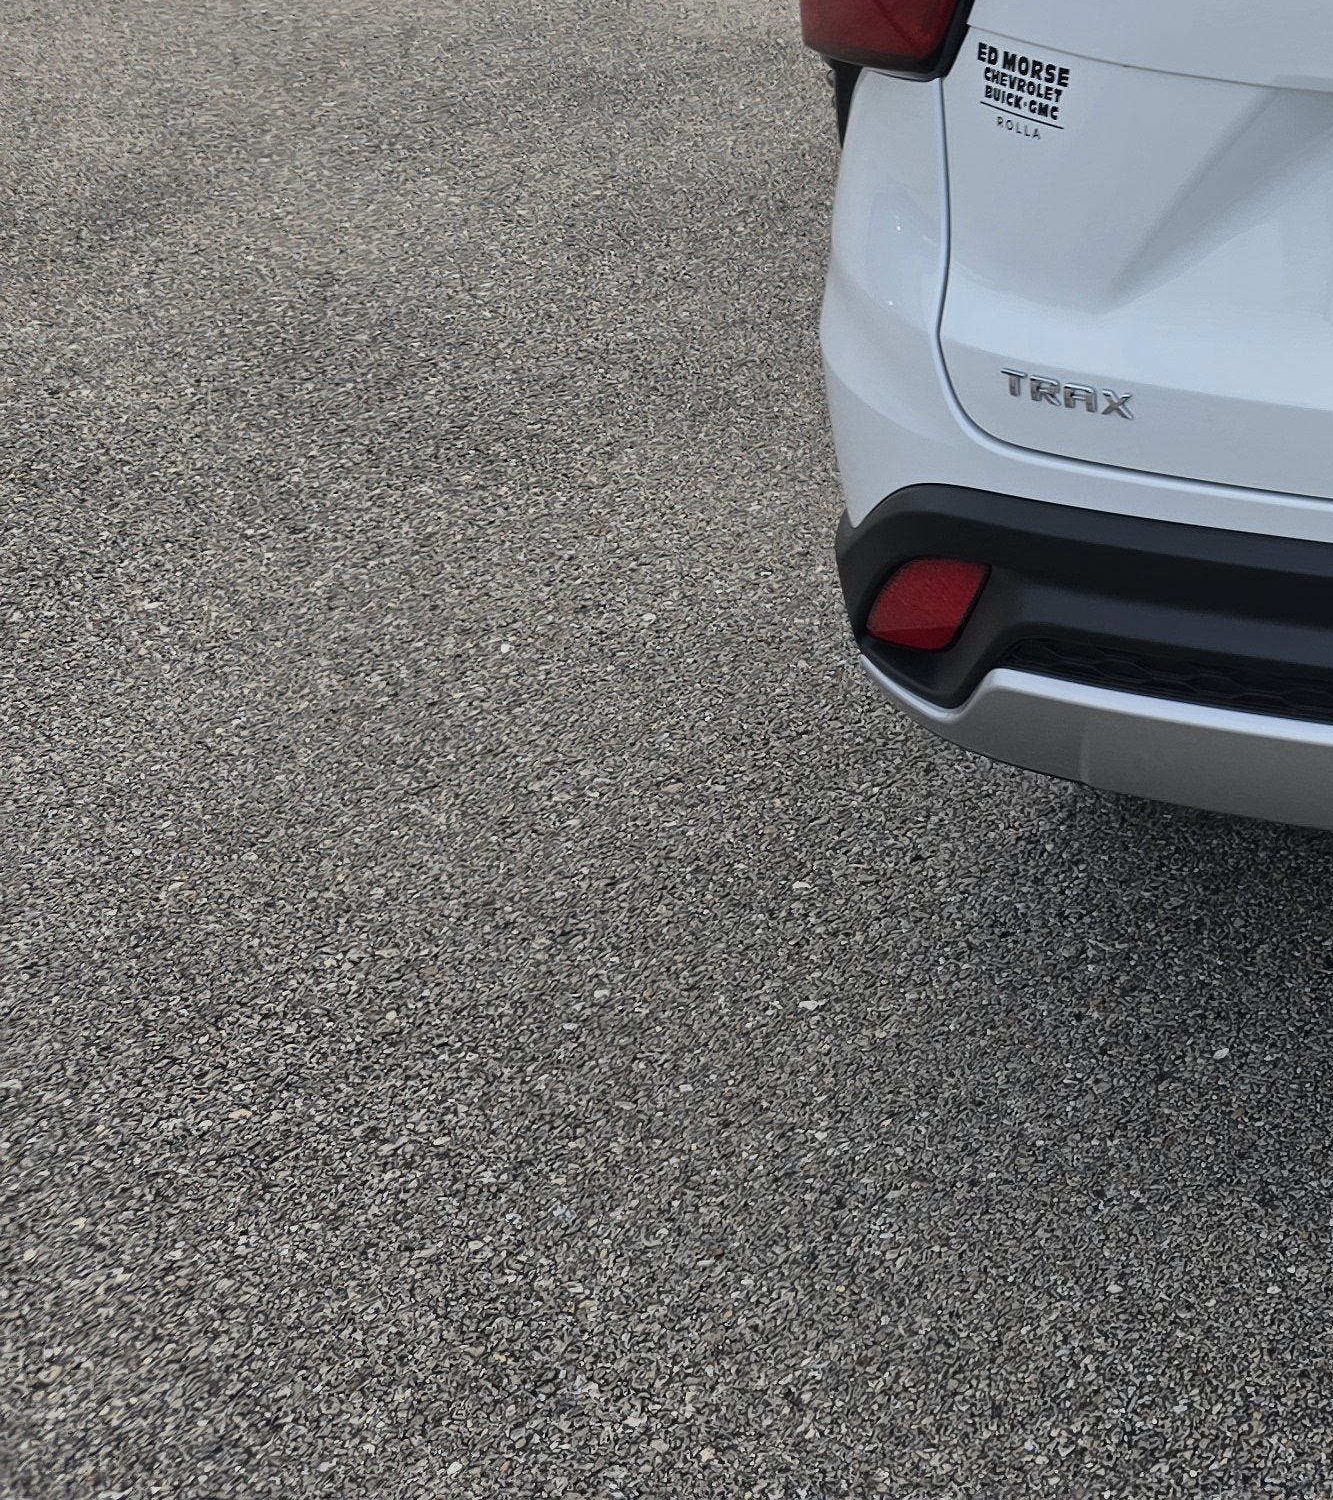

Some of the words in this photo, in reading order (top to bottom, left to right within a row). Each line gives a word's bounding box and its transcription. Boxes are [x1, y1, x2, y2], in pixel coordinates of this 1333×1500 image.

[977, 42, 999, 66] ED
[1003, 51, 1070, 88] MORSE
[984, 66, 1063, 103] CHEVROLET
[996, 116, 1041, 140] ROLLA
[1000, 368, 1135, 420] TRAX
